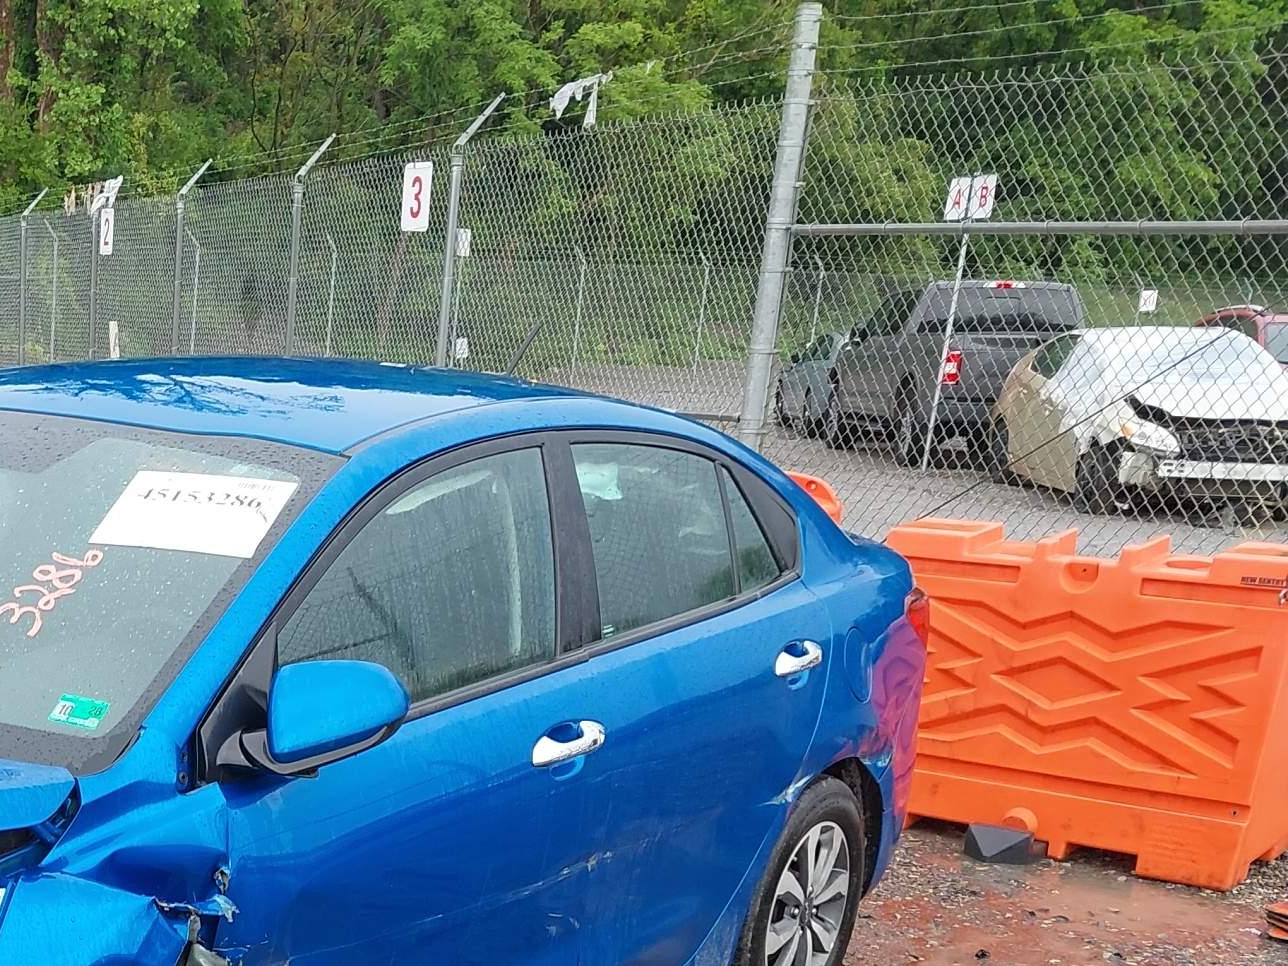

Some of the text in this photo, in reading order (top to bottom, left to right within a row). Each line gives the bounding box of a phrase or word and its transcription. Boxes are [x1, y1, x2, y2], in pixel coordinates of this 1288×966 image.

[409, 175, 423, 219] 3
[952, 187, 962, 209] A
[978, 186, 989, 209] B
[103, 217, 111, 246] 2
